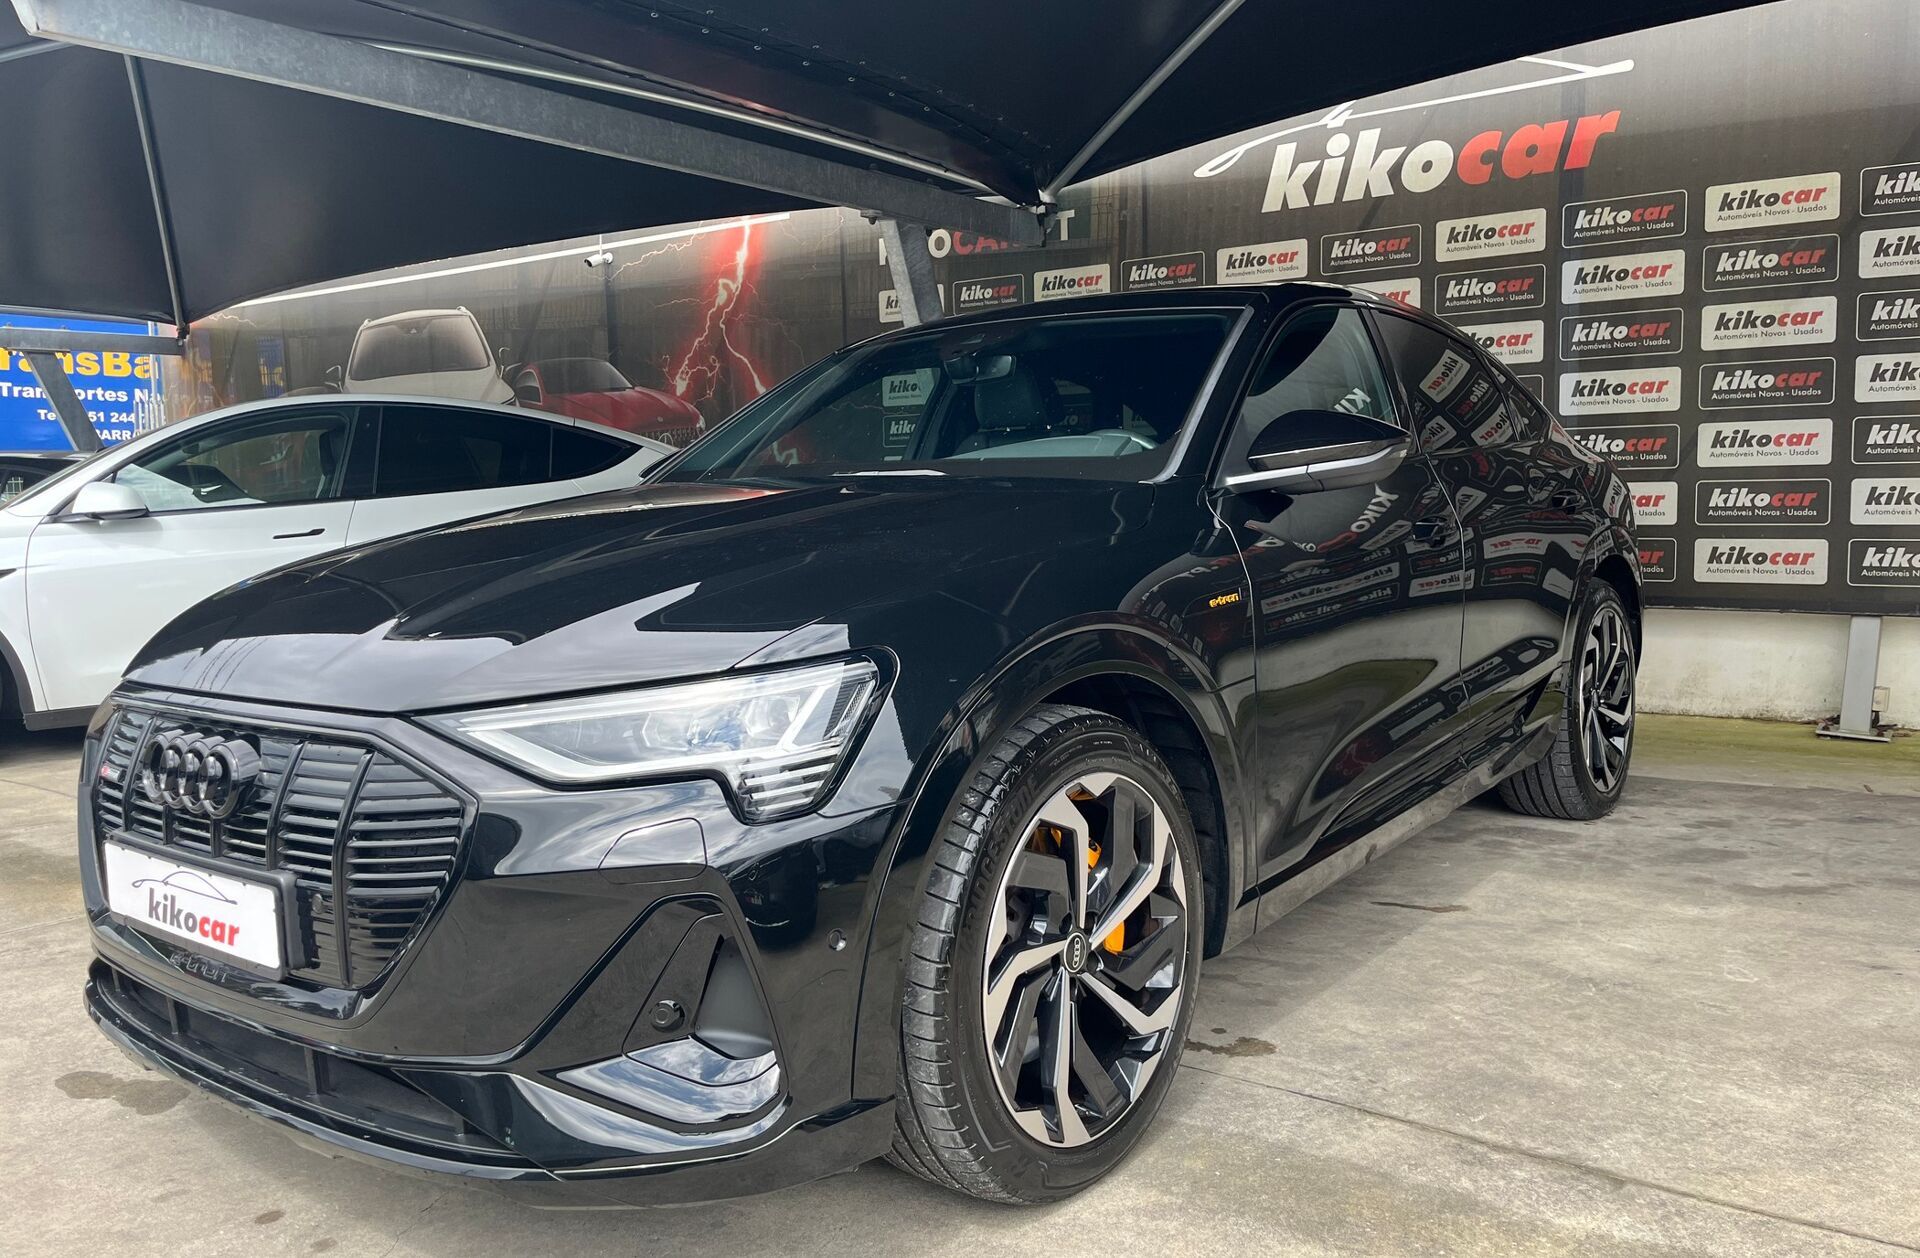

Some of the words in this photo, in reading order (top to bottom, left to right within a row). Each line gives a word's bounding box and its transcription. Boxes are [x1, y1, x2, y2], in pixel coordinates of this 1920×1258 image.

[1261, 110, 1621, 213] kikocar
[1718, 186, 1826, 212] kikocar
[1574, 204, 1674, 229] kikocar
[1717, 210, 1761, 221] Automóveis
[1764, 208, 1789, 216] Novos
[1797, 202, 1827, 213] Usados
[1447, 220, 1535, 244] kikocar
[1574, 226, 1614, 238] Automóveis
[1616, 225, 1640, 233] Novos
[1646, 219, 1673, 229] Usados
[1331, 236, 1410, 257] kikocar
[1445, 242, 1481, 252] Automóveis
[1510, 235, 1535, 246] Usados
[1226, 249, 1298, 270] kikocar
[1330, 256, 1363, 265] Automóveis
[1388, 250, 1410, 259] Usados
[1716, 248, 1825, 271] kikocar
[1130, 261, 1196, 281] kikocar
[1573, 262, 1672, 286] kikocar
[1715, 270, 1760, 280] Automóveis
[1762, 268, 1788, 276] Novos
[1795, 264, 1825, 274] Usados
[1042, 273, 1102, 291] kikocar
[1446, 276, 1533, 298] kikocar
[1572, 284, 1613, 294] Automóveis
[1645, 278, 1672, 288] Usados
[961, 284, 1017, 300] kikocar
[1444, 297, 1481, 306] Automóveis
[1483, 295, 1503, 303] Novos
[1509, 291, 1534, 300] Usados
[1714, 310, 1822, 330] kikocar
[1870, 321, 1918, 330] Automóveis
[1572, 321, 1670, 342] kikocar
[1713, 330, 1757, 339] Automóveis
[1793, 325, 1822, 334] Usados
[1508, 348, 1532, 356] Usados
[1571, 341, 1611, 350] Automóveis
[1643, 336, 1670, 345] Usados
[1571, 378, 1668, 397] kikocar
[1713, 369, 1821, 390] kikocar
[1868, 384, 1916, 392] Automóveis
[1570, 397, 1609, 406] Automóveis
[1612, 396, 1635, 404] Novos
[1641, 393, 1668, 403] Usados
[1711, 390, 1756, 399] Automóveis
[1758, 389, 1784, 397] Novos
[1791, 386, 1821, 395] Usados
[1711, 428, 1818, 448] kikocar
[1710, 448, 1754, 456] Automóveis
[1756, 448, 1781, 456] Novos
[1789, 446, 1818, 455] Usados
[1865, 446, 1914, 454] Automóveis
[1709, 487, 1817, 506] kikocar
[1708, 507, 1752, 515] Automóveis
[1754, 507, 1779, 515] Novos
[1787, 506, 1816, 515] Usados
[1864, 508, 1913, 516] Automóveis
[1707, 546, 1814, 565] kikocar
[1706, 565, 1750, 573] Automóveis
[1752, 566, 1777, 574] Novos
[1785, 565, 1814, 574] Usados
[148, 888, 240, 946] kikocar
